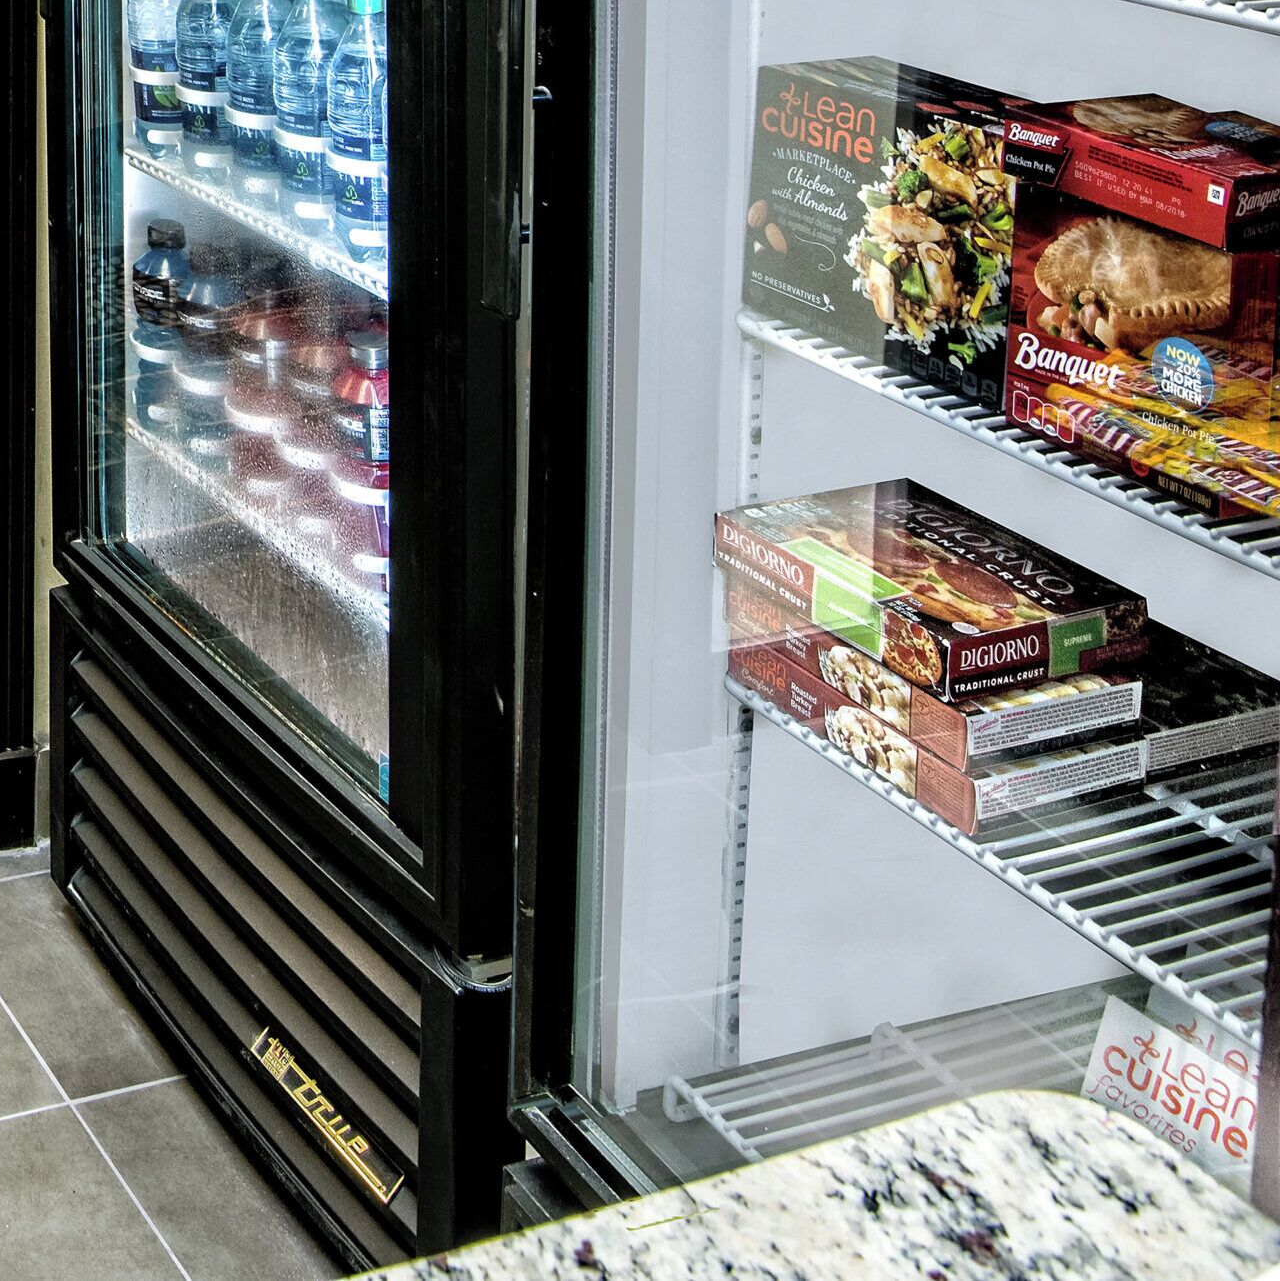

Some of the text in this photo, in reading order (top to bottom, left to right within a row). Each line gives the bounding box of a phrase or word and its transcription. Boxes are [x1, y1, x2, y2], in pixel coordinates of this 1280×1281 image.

[804, 91, 876, 137] Lean
[1008, 123, 1060, 148] Banquet
[1005, 153, 1056, 175] Chicken Pot Pie
[787, 166, 836, 197] Chicken
[794, 188, 848, 222] Almonds
[1235, 186, 1280, 217] Banque
[751, 270, 821, 304] NO PRESERVATIVES
[1014, 332, 1125, 390] Banquet
[1166, 344, 1201, 368] NOW
[1162, 368, 1202, 393] MORE
[1176, 361, 1202, 379] 20%
[1161, 380, 1203, 406] CHICKEN
[1141, 411, 1216, 444] Chicken Pot Pie
[1158, 475, 1168, 489] NET
[1169, 478, 1179, 491] WT
[1183, 484, 1192, 498] OZ
[718, 551, 808, 610] TRADITIONAL CRUST
[985, 562, 1056, 608] CRUST
[1063, 633, 1092, 647] SUPREME
[790, 681, 817, 705] Roasted
[954, 667, 1044, 694] TRADITIONAL CRUST
[790, 691, 813, 711] Turkey
[790, 700, 812, 719] Breast
[1162, 1046, 1258, 1133] Lean
